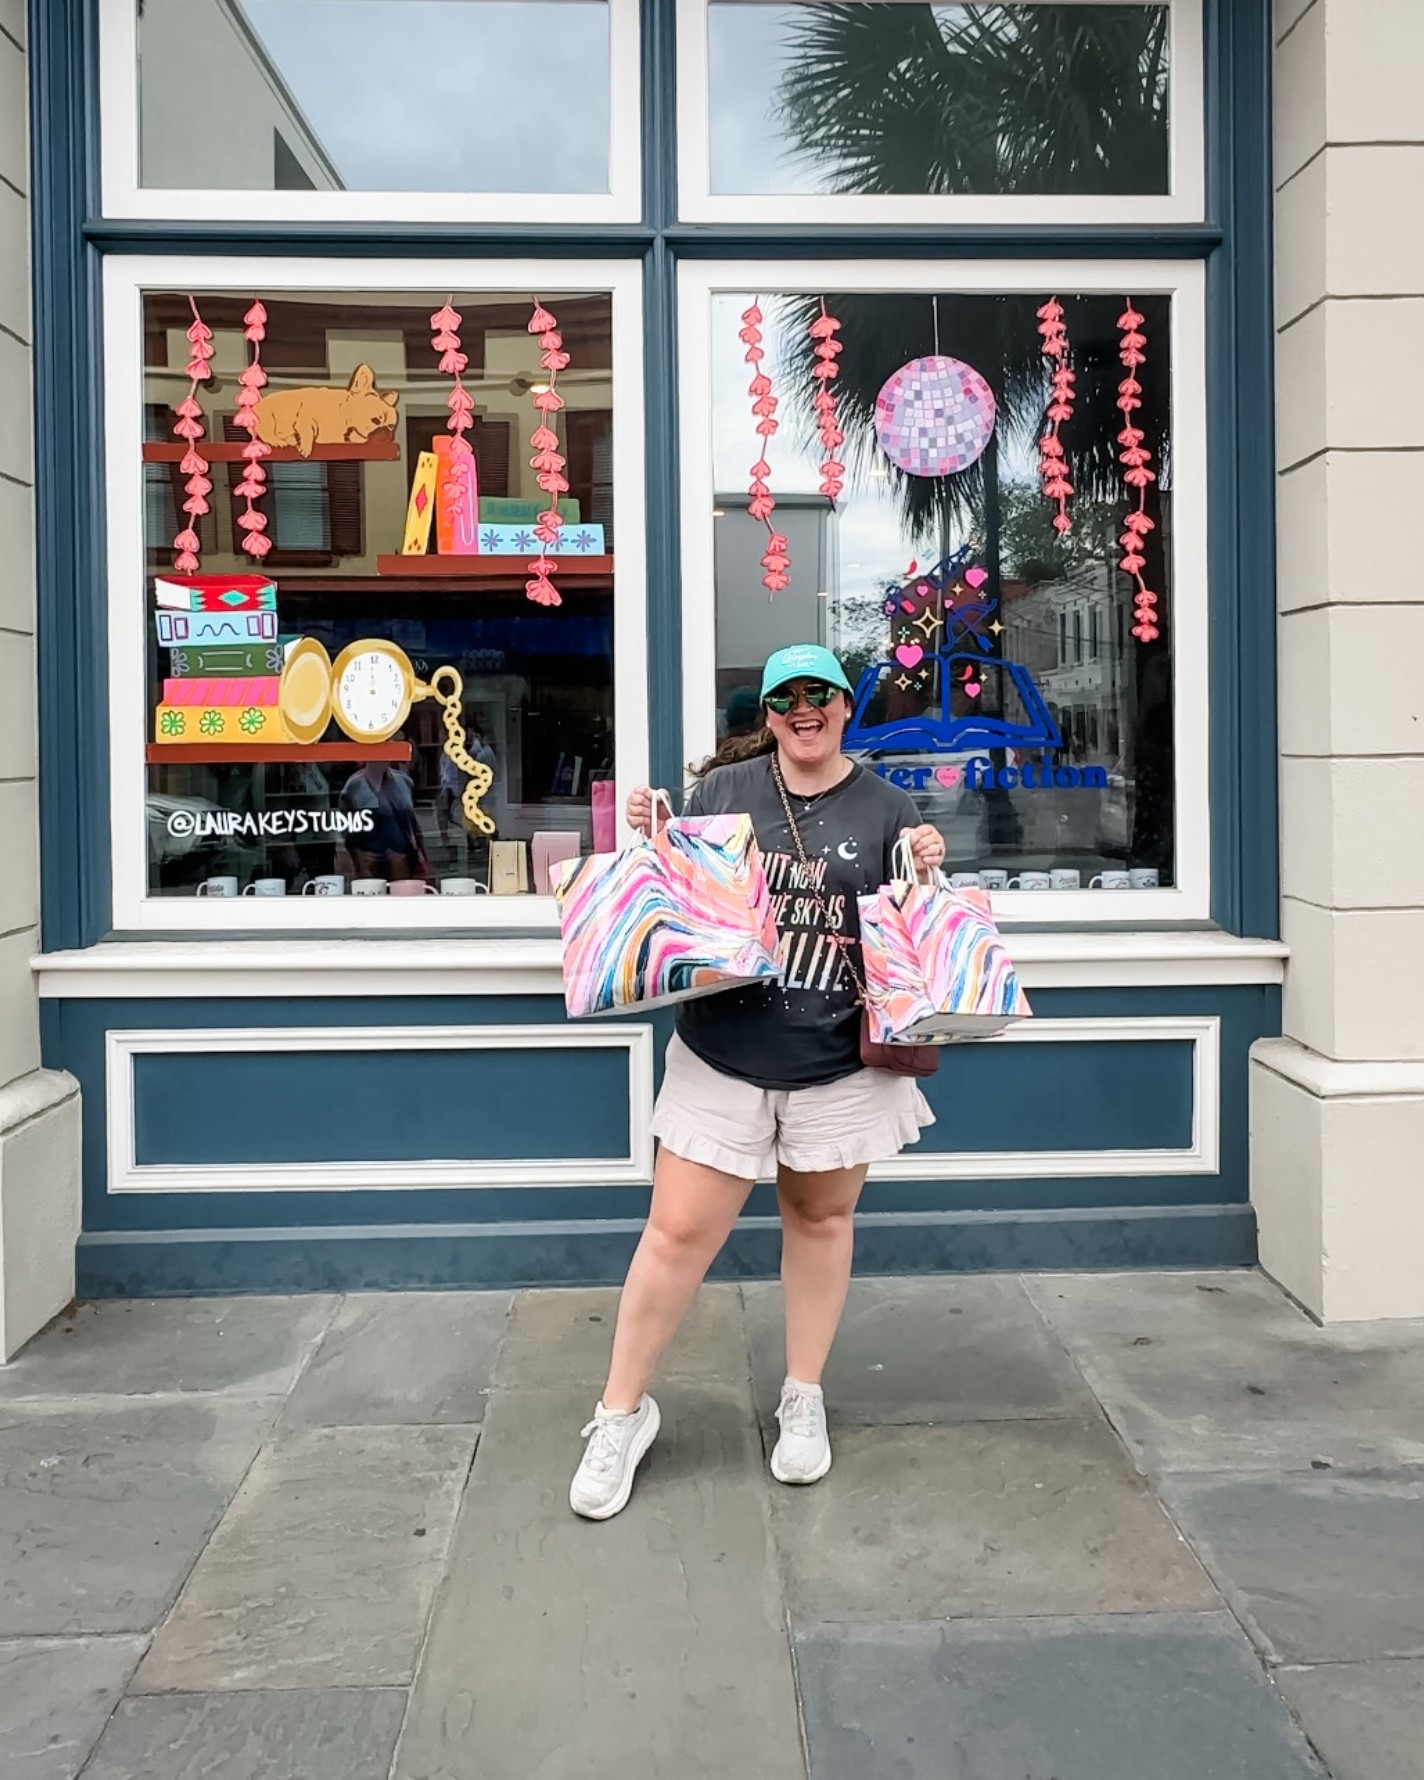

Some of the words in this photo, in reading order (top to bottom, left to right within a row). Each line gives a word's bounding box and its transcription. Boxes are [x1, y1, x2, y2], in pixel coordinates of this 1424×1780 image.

[963, 754, 1108, 791] fiction
[760, 851, 792, 890] UT
[769, 894, 792, 926] HE
[790, 897, 824, 926] SKY
[824, 894, 846, 930] IS
